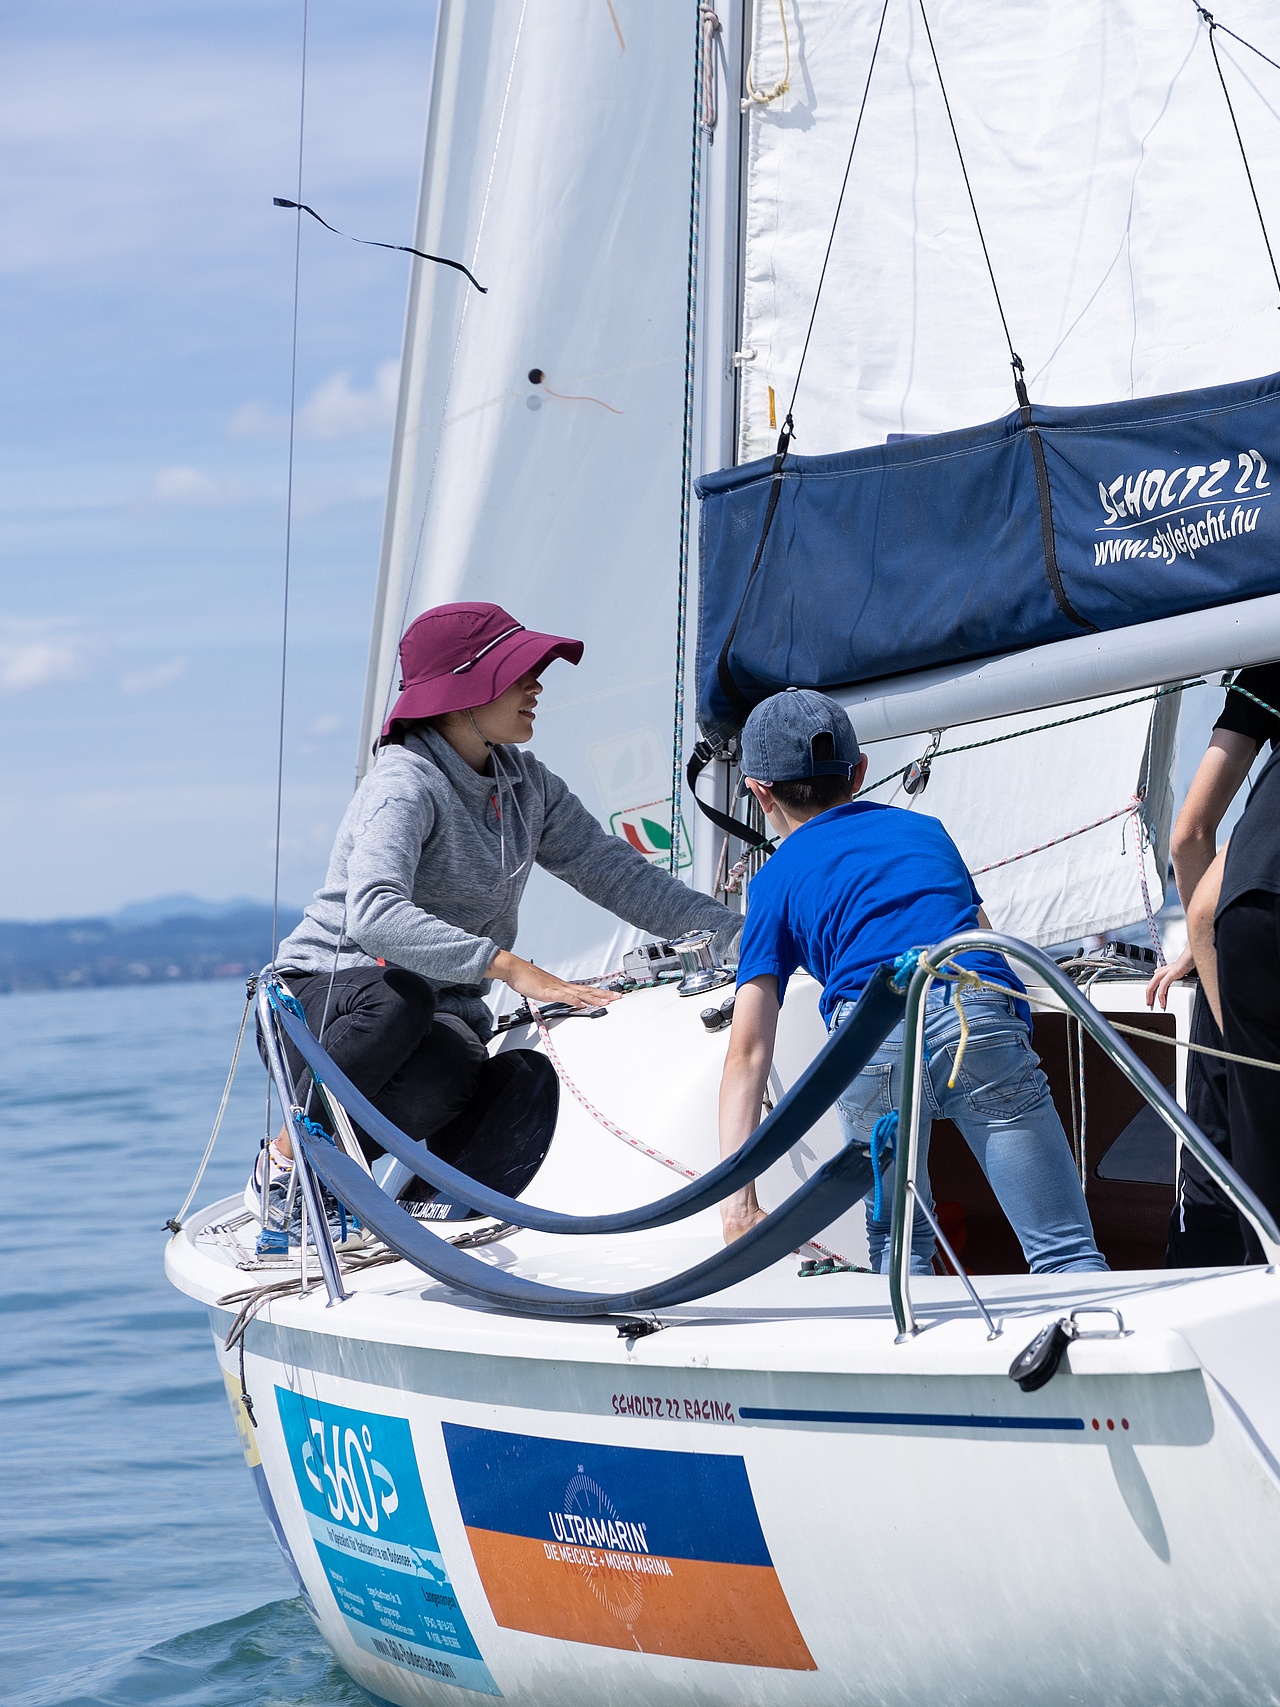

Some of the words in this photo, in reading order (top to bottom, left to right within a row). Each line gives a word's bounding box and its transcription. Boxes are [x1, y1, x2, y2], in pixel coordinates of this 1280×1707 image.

[1234, 449, 1271, 493] 22
[1094, 505, 1261, 566] www.stylejacht.hu
[611, 1394, 664, 1418] SCHOLTZ
[666, 1398, 681, 1419] 22
[683, 1399, 735, 1423] RACING
[543, 1542, 560, 1561] DIE
[558, 1545, 599, 1567] MEICHLE
[604, 1552, 634, 1572] MOHR
[633, 1556, 673, 1577] MARINA
